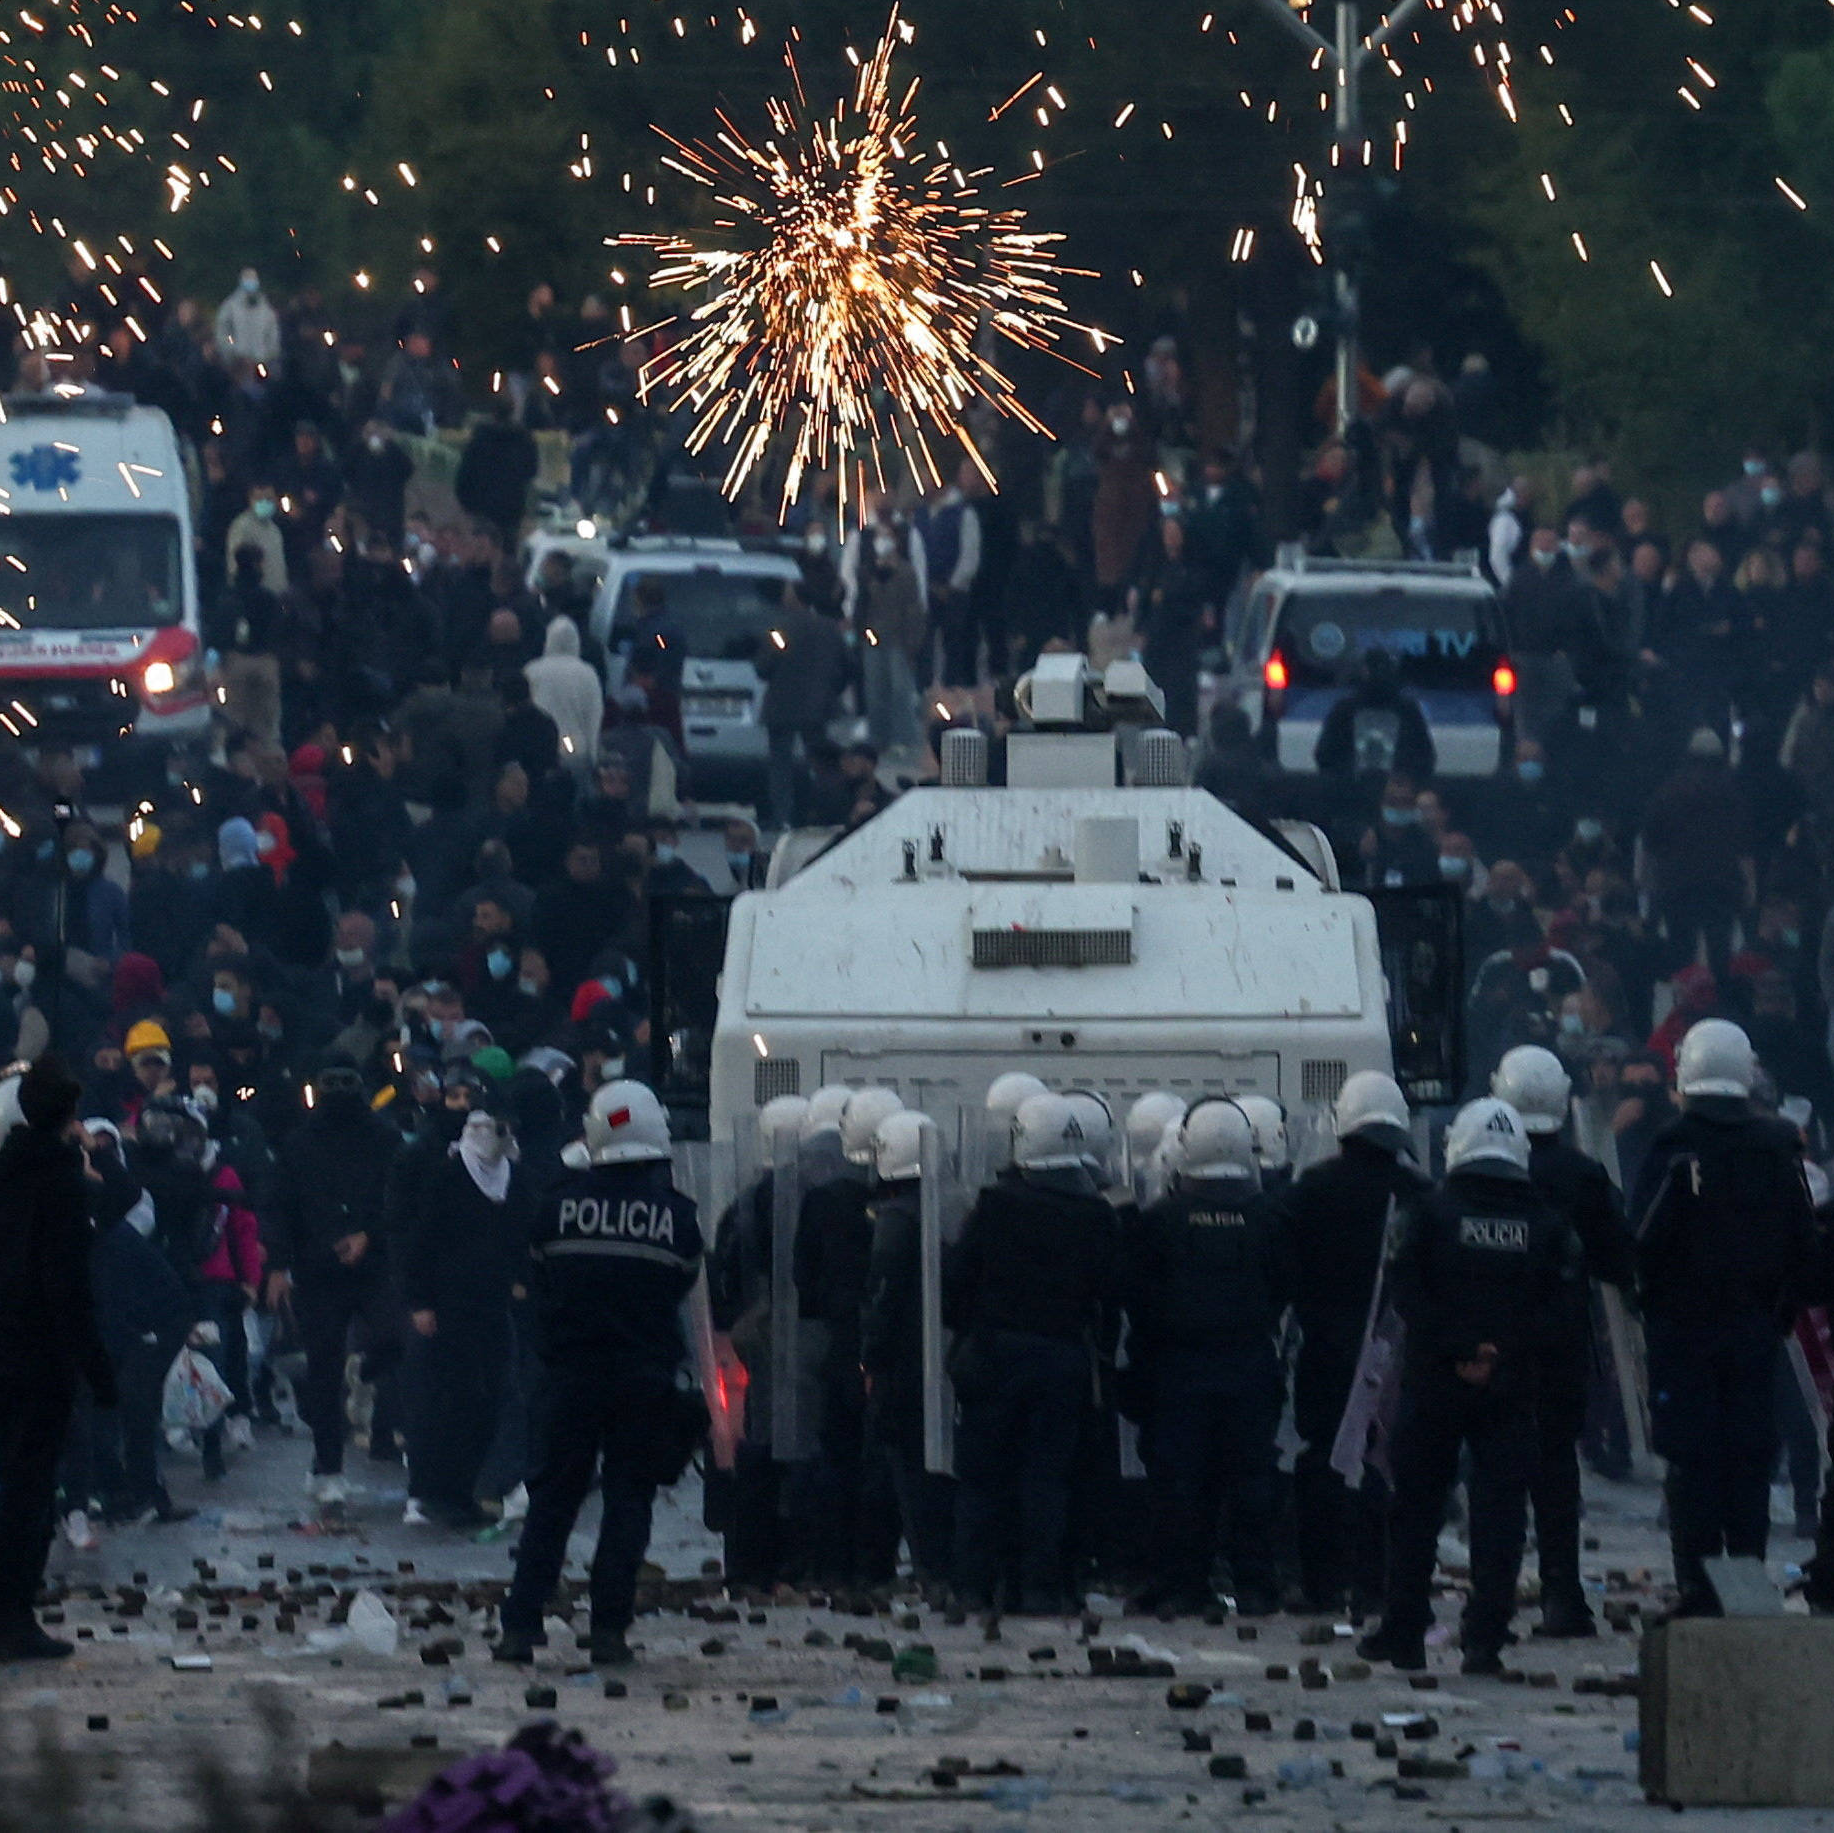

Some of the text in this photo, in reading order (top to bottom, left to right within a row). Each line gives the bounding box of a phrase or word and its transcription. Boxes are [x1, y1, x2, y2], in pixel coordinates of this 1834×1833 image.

[1433, 629, 1476, 658] TV
[559, 1197, 675, 1246] POLICIA
[1461, 1218, 1526, 1247] POLICIA
